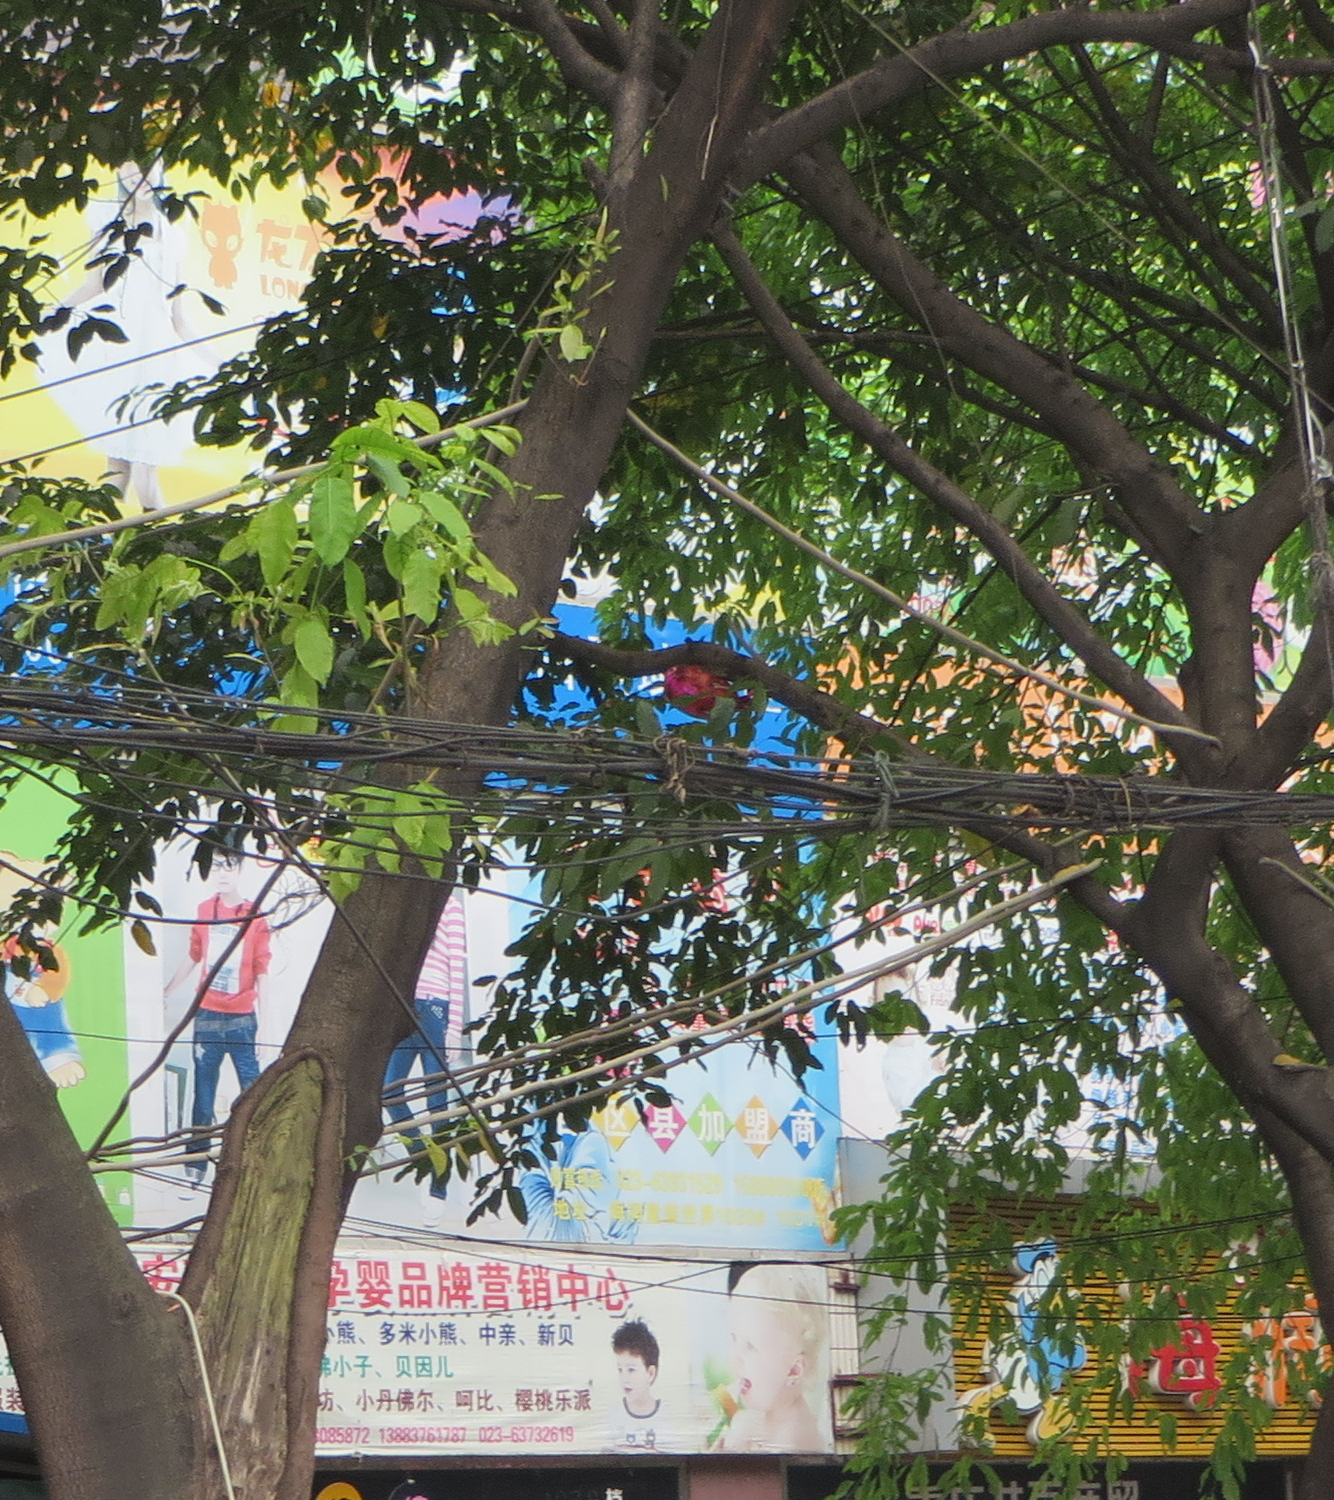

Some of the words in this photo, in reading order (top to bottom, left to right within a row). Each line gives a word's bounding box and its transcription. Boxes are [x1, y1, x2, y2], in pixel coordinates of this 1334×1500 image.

[603, 1102, 818, 1147] 区县加盟商
[328, 1259, 632, 1312] 孕婴品牌营销中心
